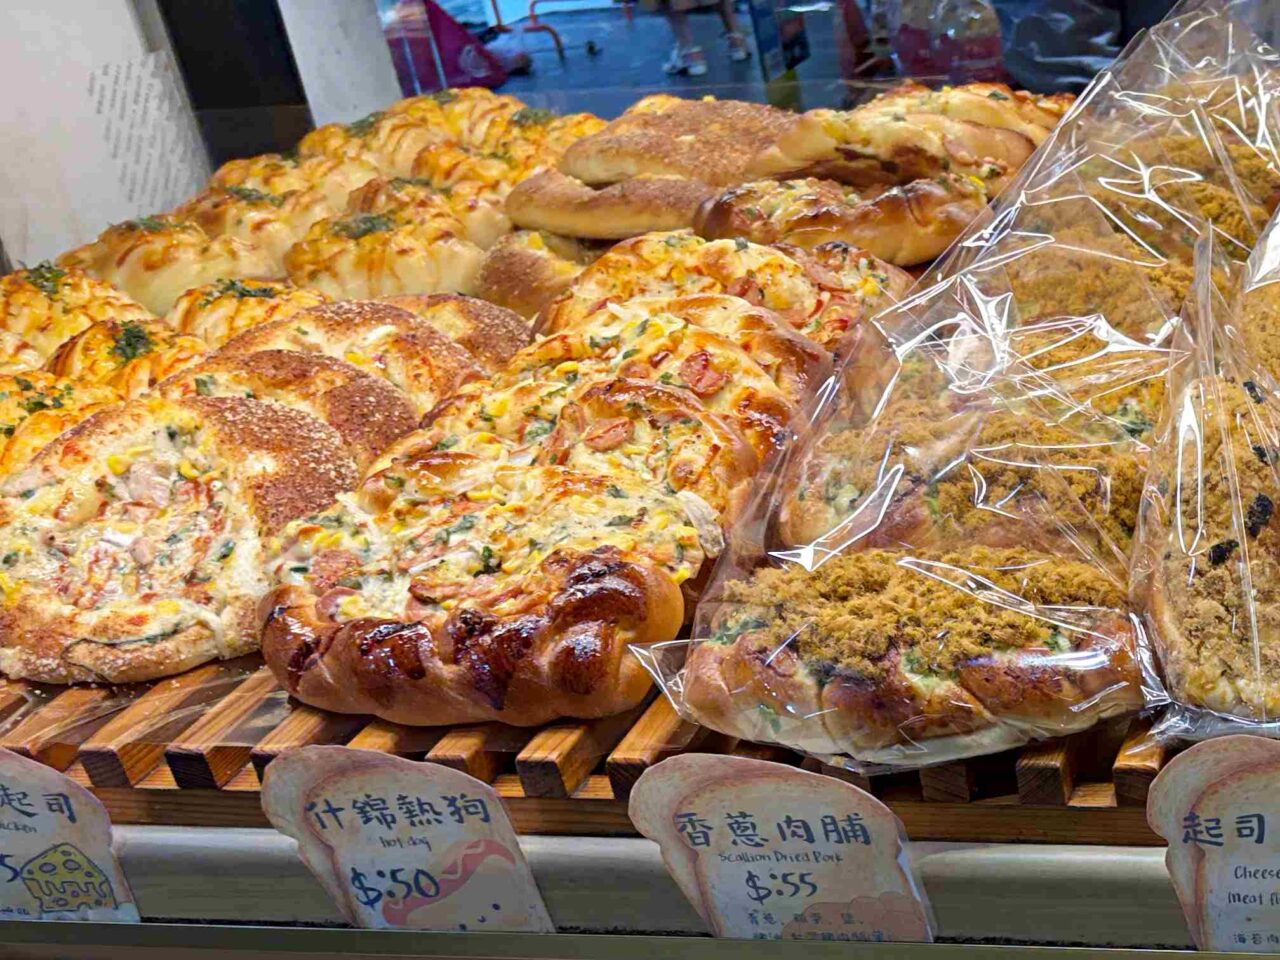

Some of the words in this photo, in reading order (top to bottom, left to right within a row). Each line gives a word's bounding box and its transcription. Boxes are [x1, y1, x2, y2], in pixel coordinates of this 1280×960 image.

[305, 793, 491, 830] 什錦熱狗
[774, 850, 811, 863] Dried
